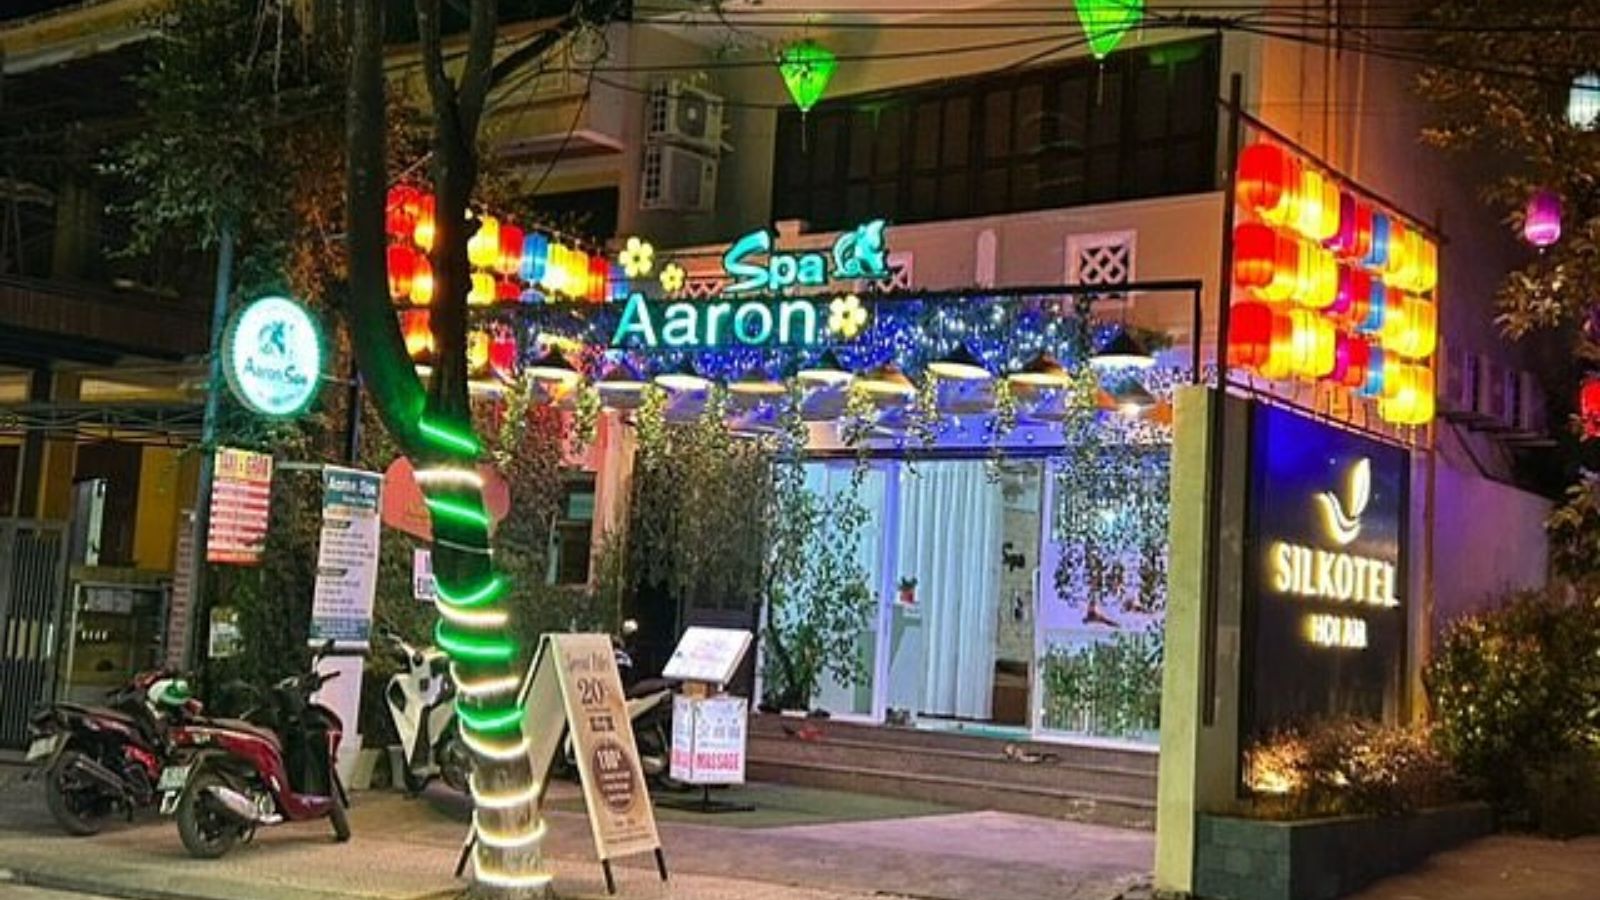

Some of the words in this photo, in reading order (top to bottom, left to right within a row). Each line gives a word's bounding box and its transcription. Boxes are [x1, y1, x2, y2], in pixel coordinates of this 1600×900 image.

[723, 230, 824, 292] Spa
[612, 293, 817, 347] Aaron
[1270, 541, 1400, 608] SILKOTEL
[697, 752, 740, 770] MASSAGE
